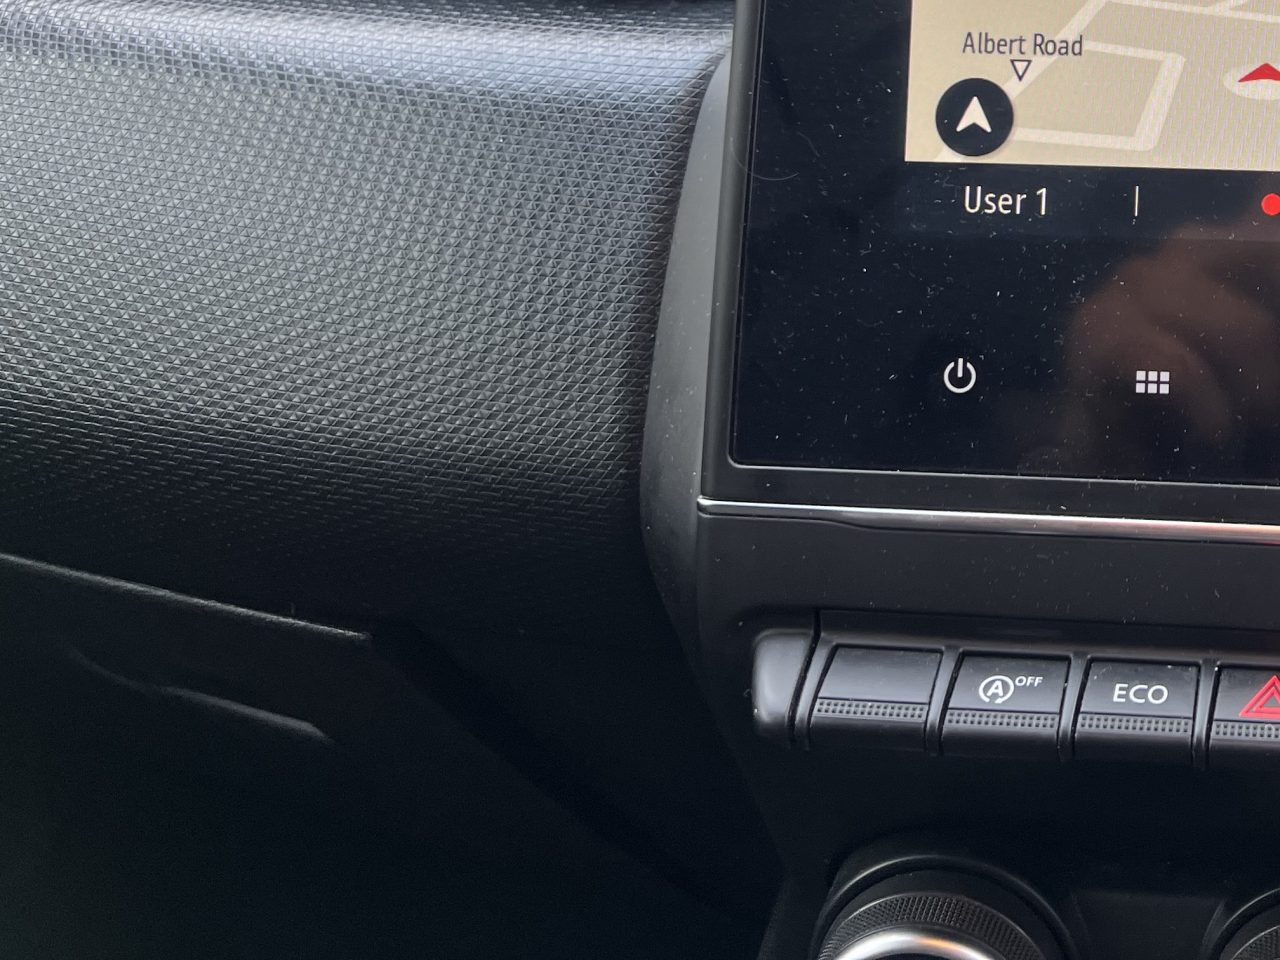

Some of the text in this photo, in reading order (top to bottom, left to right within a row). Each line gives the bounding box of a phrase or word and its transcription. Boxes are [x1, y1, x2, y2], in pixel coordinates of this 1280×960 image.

[962, 31, 1083, 56] Albert Road
[964, 185, 1047, 216] User 1
[1015, 675, 1044, 689] OFF
[1112, 683, 1169, 705] ECO
